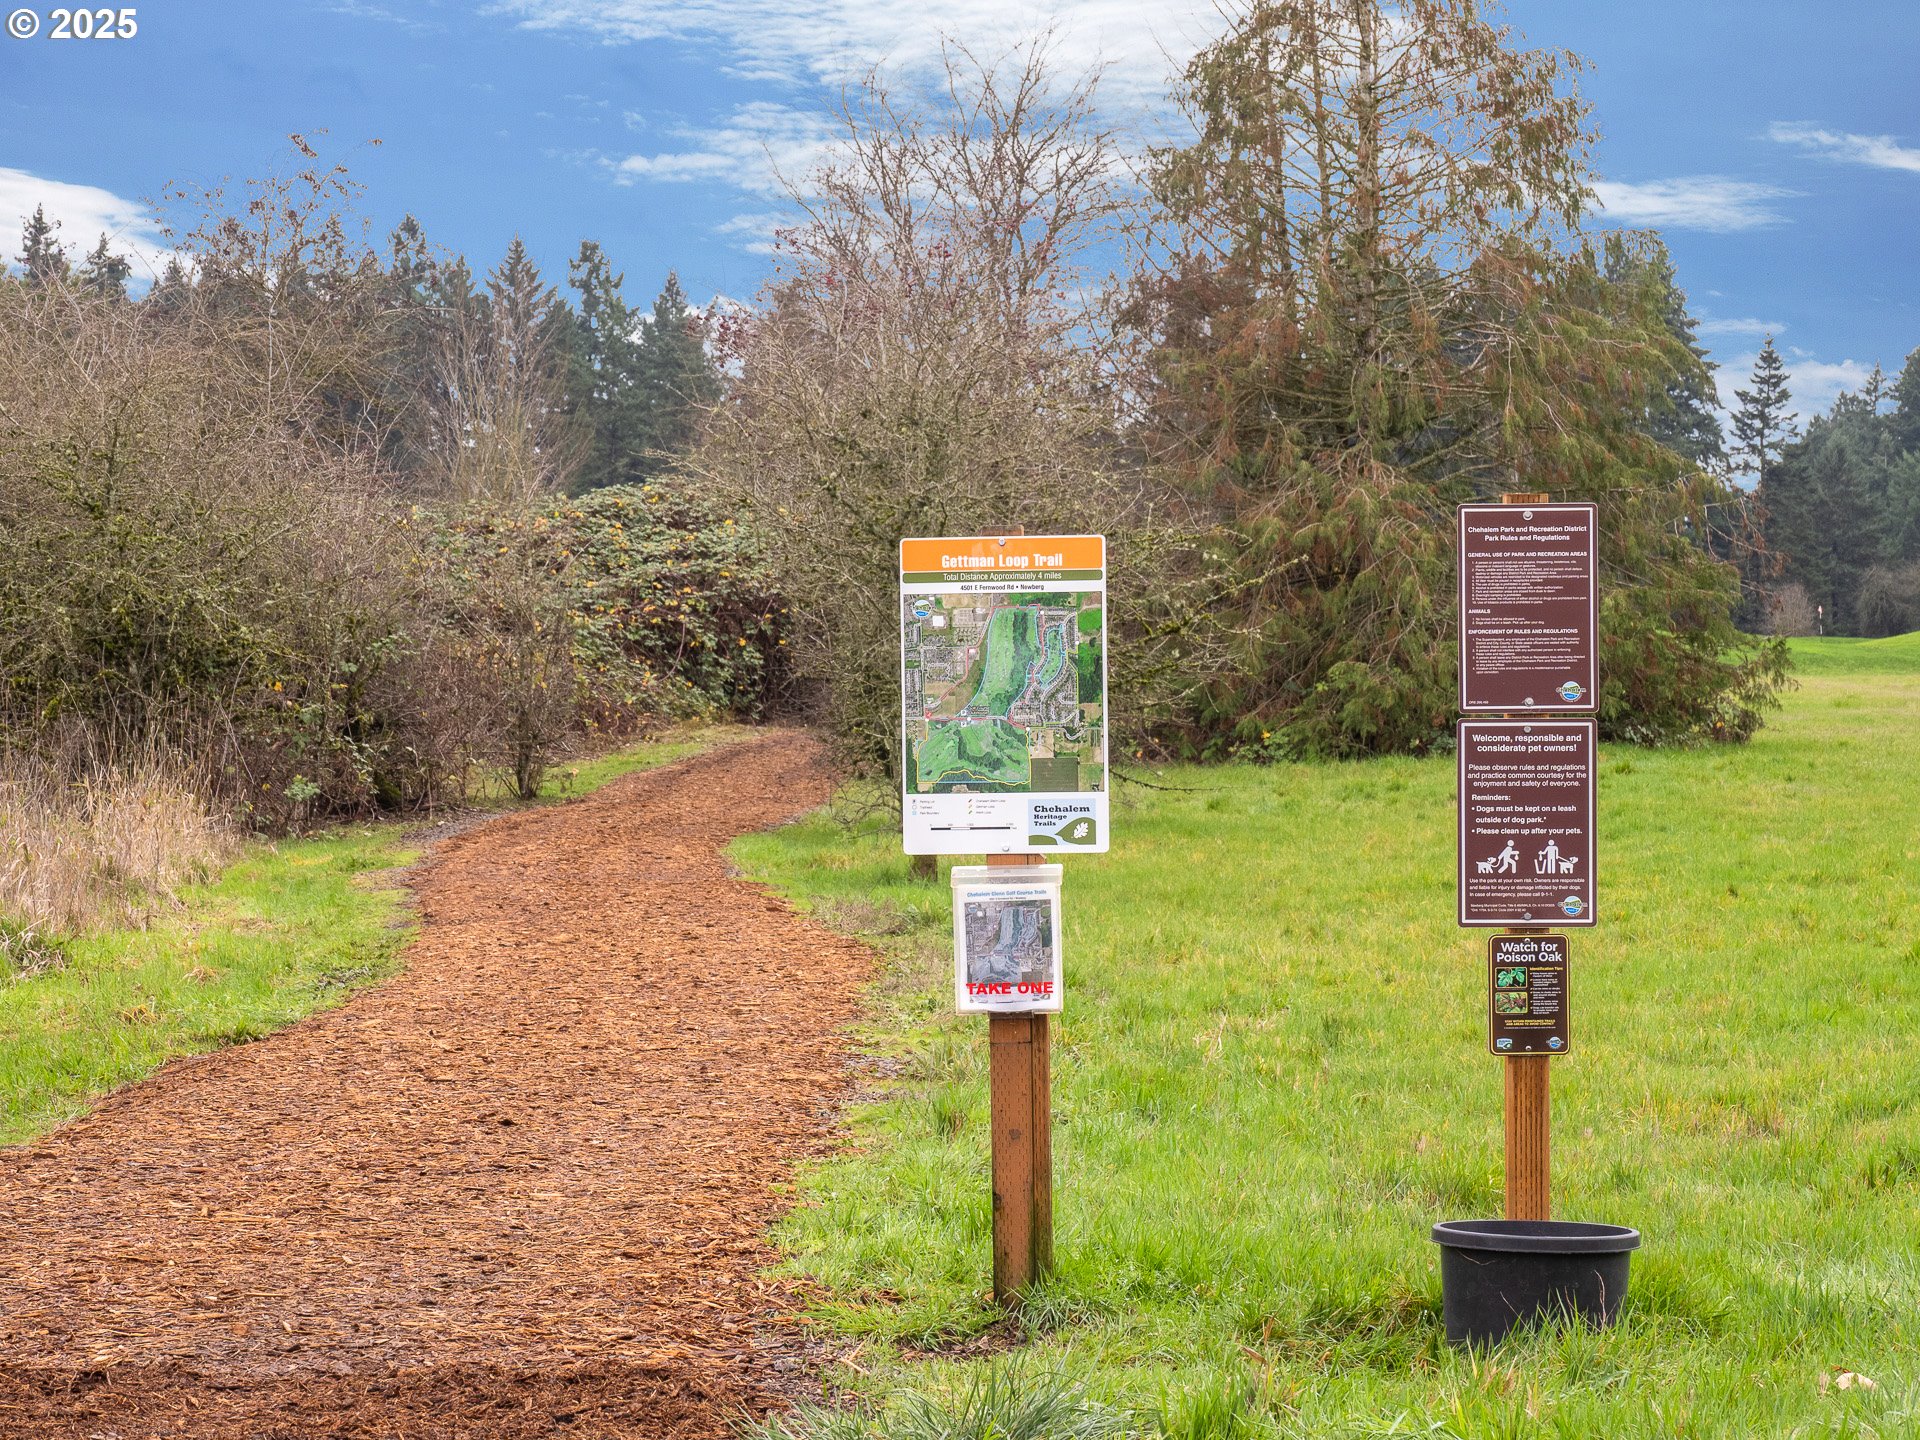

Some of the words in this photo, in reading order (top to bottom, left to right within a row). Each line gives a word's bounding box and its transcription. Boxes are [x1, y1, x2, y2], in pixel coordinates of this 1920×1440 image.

[941, 554, 995, 569] Gettman
[999, 554, 1029, 568] Loop
[1033, 553, 1063, 567] Trail
[990, 573, 1037, 581] Approximately
[1515, 734, 1564, 742] responsible
[1528, 745, 1541, 753] pet
[1501, 942, 1538, 952] Watch
[1541, 942, 1558, 952] for
[1497, 953, 1536, 962] Poison
[1539, 952, 1562, 961] Oak
[966, 982, 1012, 995] TAKE
[1018, 982, 1053, 994] ONE
